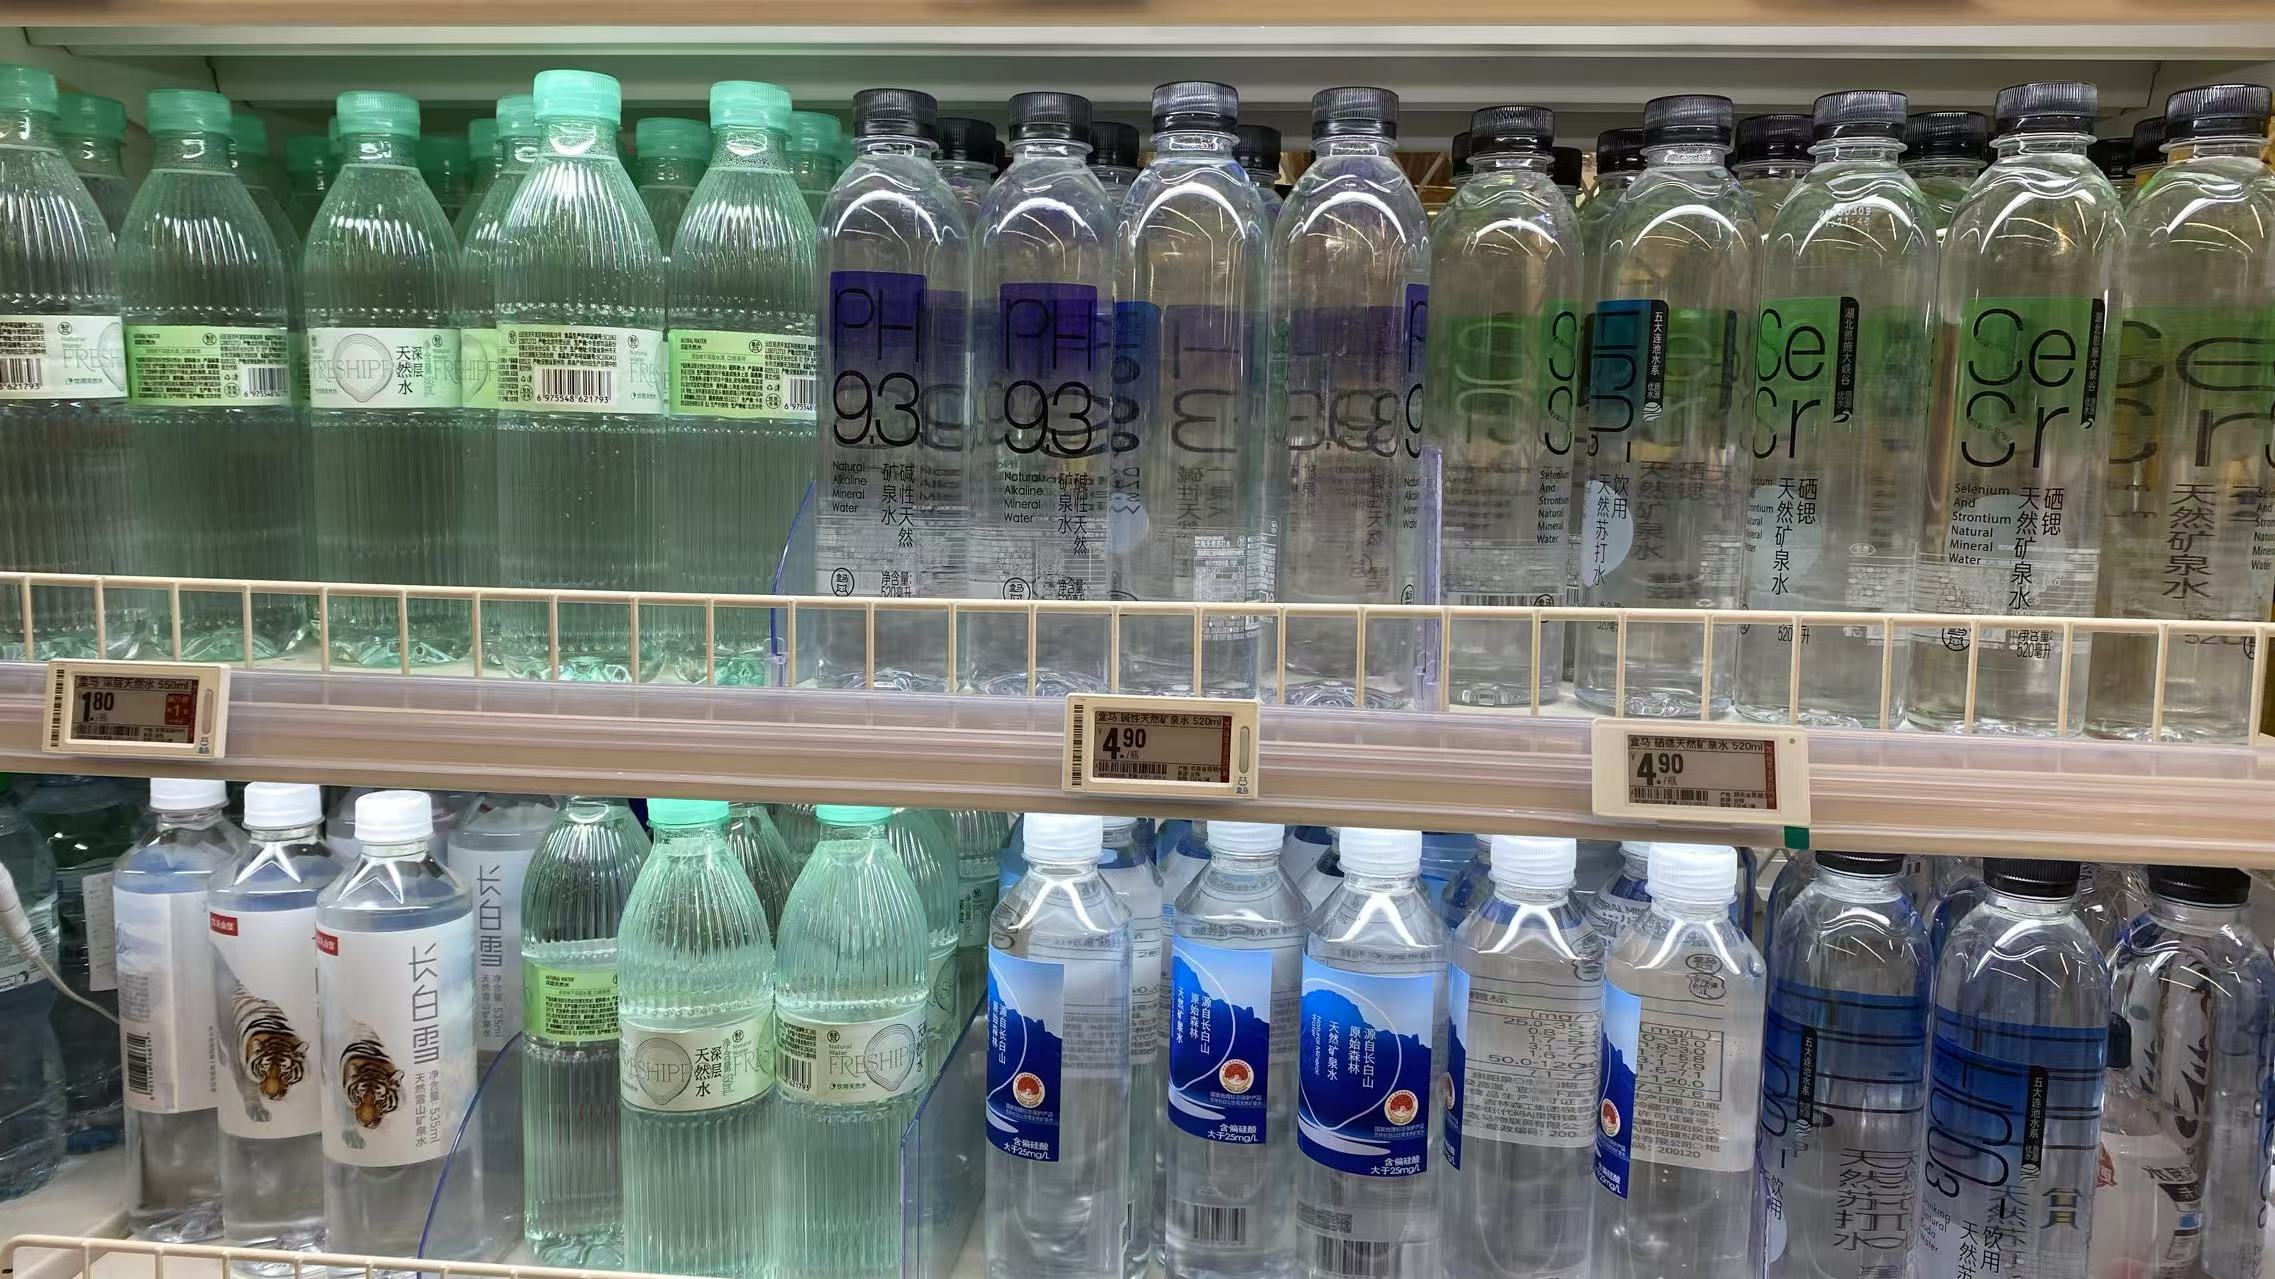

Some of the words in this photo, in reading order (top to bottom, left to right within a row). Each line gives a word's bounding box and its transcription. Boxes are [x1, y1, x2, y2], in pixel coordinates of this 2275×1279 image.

[834, 288, 920, 368] PH
[1005, 299, 1092, 371] PH
[1650, 312, 1663, 376] 五大连池水系
[1968, 308, 2076, 387] Se
[396, 346, 413, 394] 天然水
[412, 346, 424, 377] 深层
[545, 394, 574, 402] 975548
[833, 370, 920, 446] 9.3
[1004, 380, 1092, 454] 9.3
[1961, 391, 2069, 468] Sr
[833, 460, 865, 472] Natural
[833, 475, 867, 486] Alkaline
[1004, 472, 1042, 482] Natural
[833, 489, 865, 500] Mineral
[881, 463, 898, 526] 矿泉水
[1004, 485, 1043, 496] Alkaline
[1004, 499, 1041, 509] Mineral
[1058, 472, 1072, 534] 矿泉水
[1540, 484, 1556, 494] And
[1612, 474, 1629, 520] 饮用
[1796, 478, 1818, 524] 硒锶
[1953, 498, 1976, 508] And
[1954, 483, 2010, 496] Selenium
[833, 502, 859, 513] Water
[899, 463, 915, 547] 碱性天然
[1004, 513, 1034, 523] Water
[1073, 472, 1087, 555] 碱性天然
[1952, 511, 2012, 525] Strontium
[2042, 487, 2065, 536] 硒锶
[1536, 535, 1559, 545] Water
[1537, 522, 1564, 532] Mineral
[1593, 473, 1610, 586] 天然苏打水
[1771, 477, 1795, 595] 天然矿泉水
[1951, 525, 1994, 538] Natural
[1948, 553, 1982, 565] Water
[1949, 539, 1994, 552] Mineral
[2008, 487, 2041, 610] 天然矿泉水
[881, 570, 912, 586] 净含量:
[2016, 642, 2052, 658] 520毫升
[157, 680, 189, 690] 550ml
[1098, 713, 1117, 722] 盒马
[1121, 713, 1189, 725] 碱性天然矿泉水
[1192, 717, 1221, 727] 520ml
[1630, 737, 1651, 747] 盒马
[1732, 741, 1763, 751] 520ml
[477, 865, 503, 967] 长白雪
[408, 942, 439, 1065] 长白雪
[1176, 987, 1184, 1044] 天然矿泉水
[1190, 993, 1199, 1040] 原始森林
[1200, 996, 1211, 1055] 源自长白山
[711, 1046, 722, 1079] 深层
[1327, 1020, 1340, 1081] 天然矿泉水
[1348, 1026, 1361, 1075] 原始森林
[1363, 1028, 1376, 1089] 源自长白山
[695, 1047, 711, 1097] 天然水
[2028, 1076, 2044, 1138] 五大连池水系
[1013, 1136, 1049, 1151] 含偏硅酸
[1208, 1130, 1258, 1144] 大于25mg/L
[1220, 1123, 1257, 1133] 含偏硅酸
[1003, 1142, 1050, 1160] 大于25mg/L
[1385, 1155, 1420, 1166] 含偏硅酸
[1658, 1147, 1702, 1159] 200120
[1371, 1163, 1421, 1175] 大于25mg/L
[1980, 1224, 2002, 1273] 饮用
